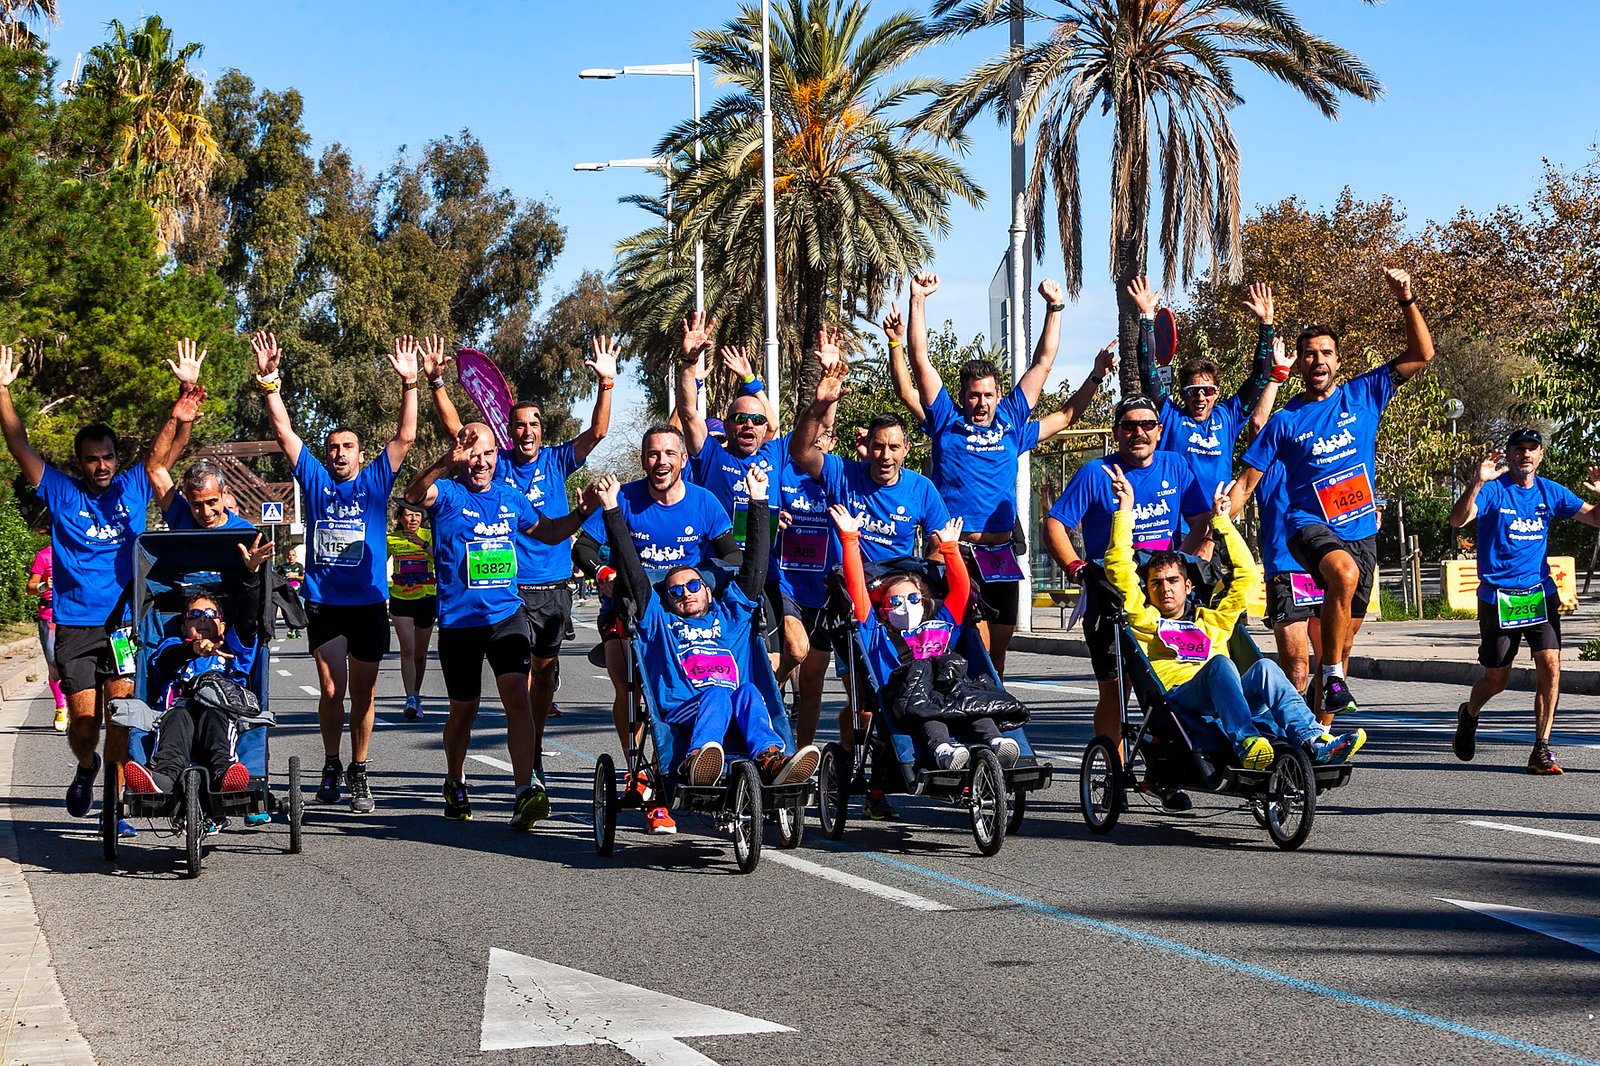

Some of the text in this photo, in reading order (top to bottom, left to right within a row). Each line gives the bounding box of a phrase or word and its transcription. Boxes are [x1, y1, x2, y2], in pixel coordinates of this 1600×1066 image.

[1333, 491, 1364, 509] 1429
[325, 541, 352, 553] 1157
[475, 562, 512, 575] 13827
[1507, 604, 1538, 616] 7236
